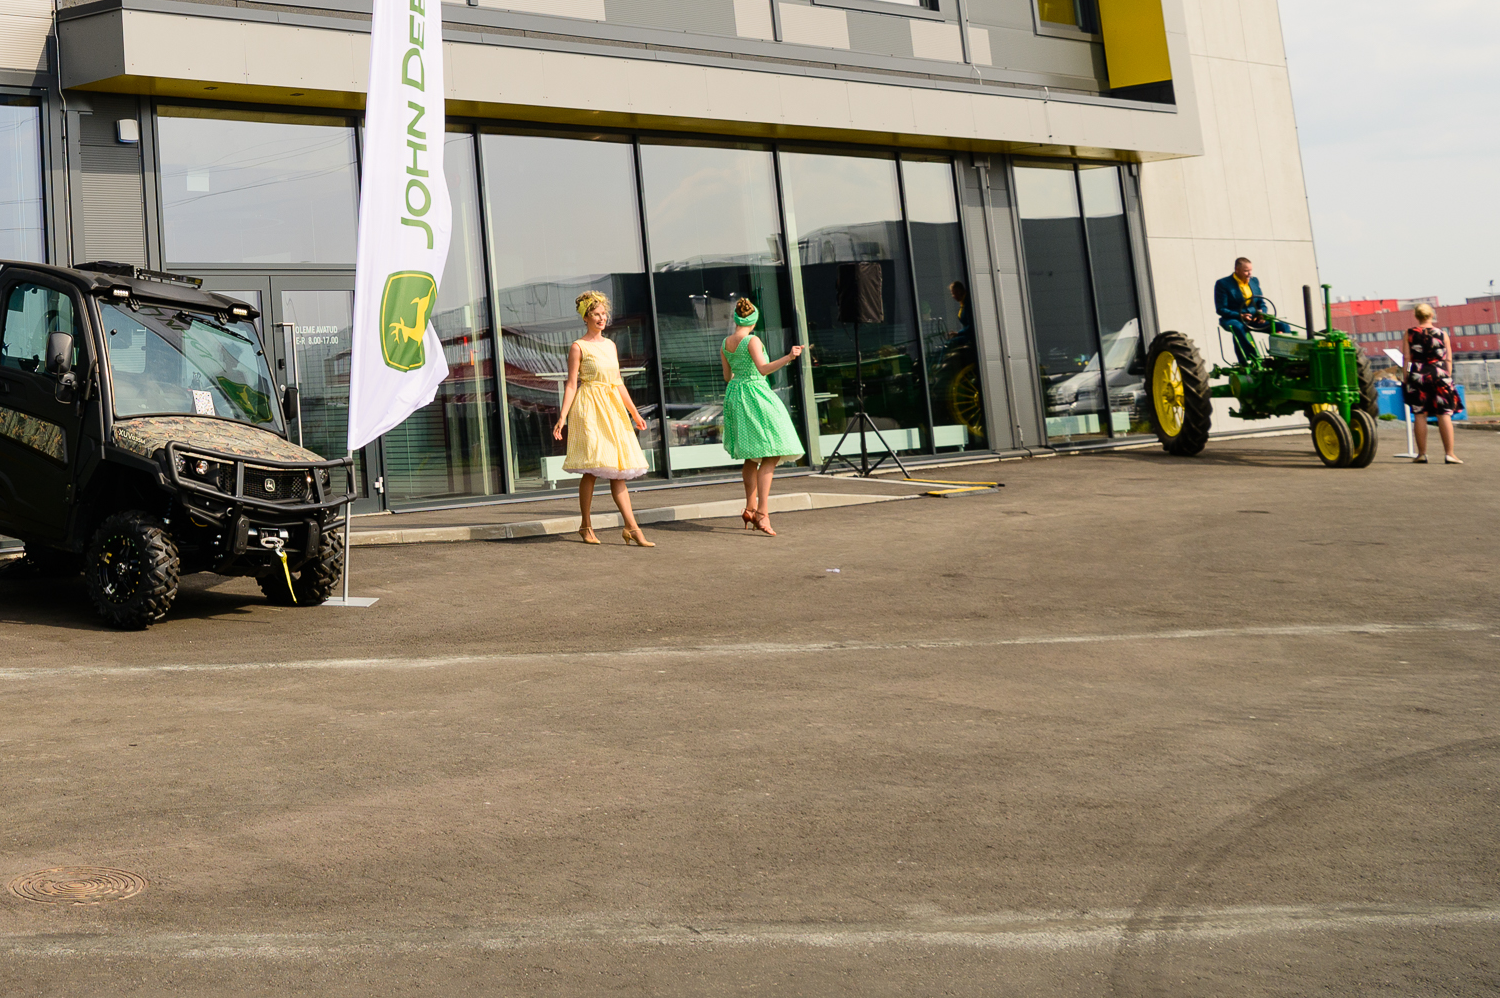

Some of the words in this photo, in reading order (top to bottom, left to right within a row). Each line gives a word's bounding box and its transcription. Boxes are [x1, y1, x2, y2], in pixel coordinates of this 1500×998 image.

[400, 100, 435, 250] JOHN
[295, 325, 316, 334] OLEME
[316, 325, 338, 334] AVATUD
[295, 337, 306, 345] E-R
[308, 336, 339, 345] 8.00-17.00
